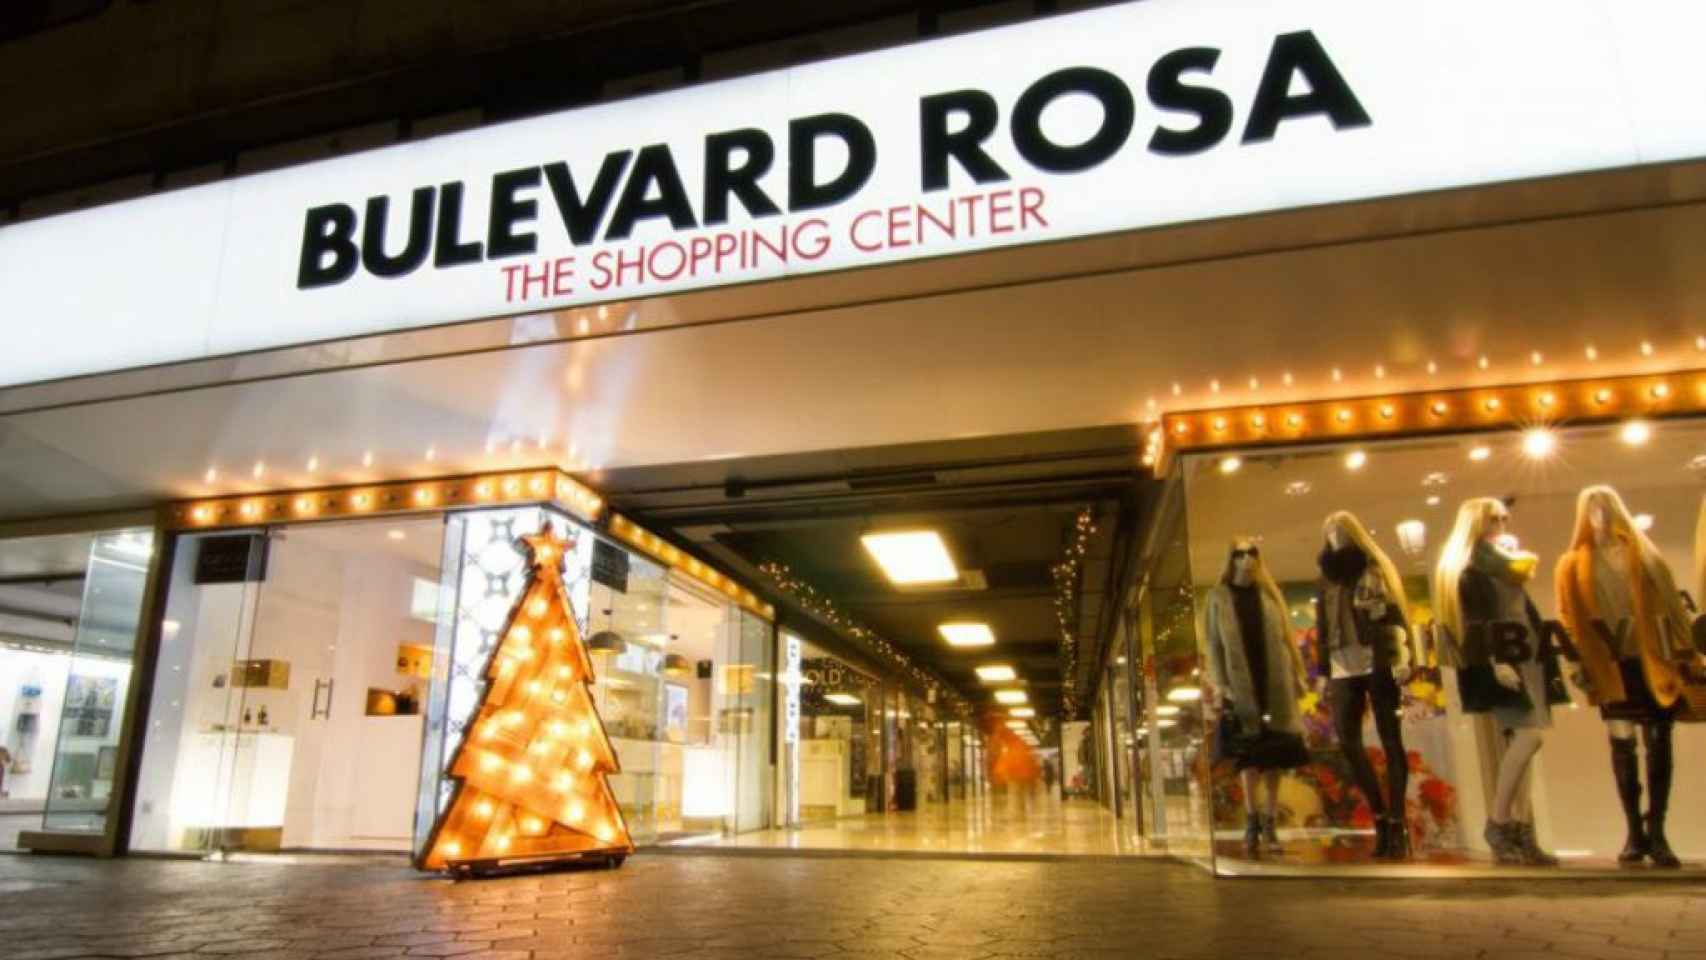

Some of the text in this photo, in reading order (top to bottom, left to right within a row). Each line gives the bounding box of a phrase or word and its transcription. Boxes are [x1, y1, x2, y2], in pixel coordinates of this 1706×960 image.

[297, 30, 1372, 289] BULEVARD ROSA
[501, 187, 1048, 301] THE SHOPPING CENTER
